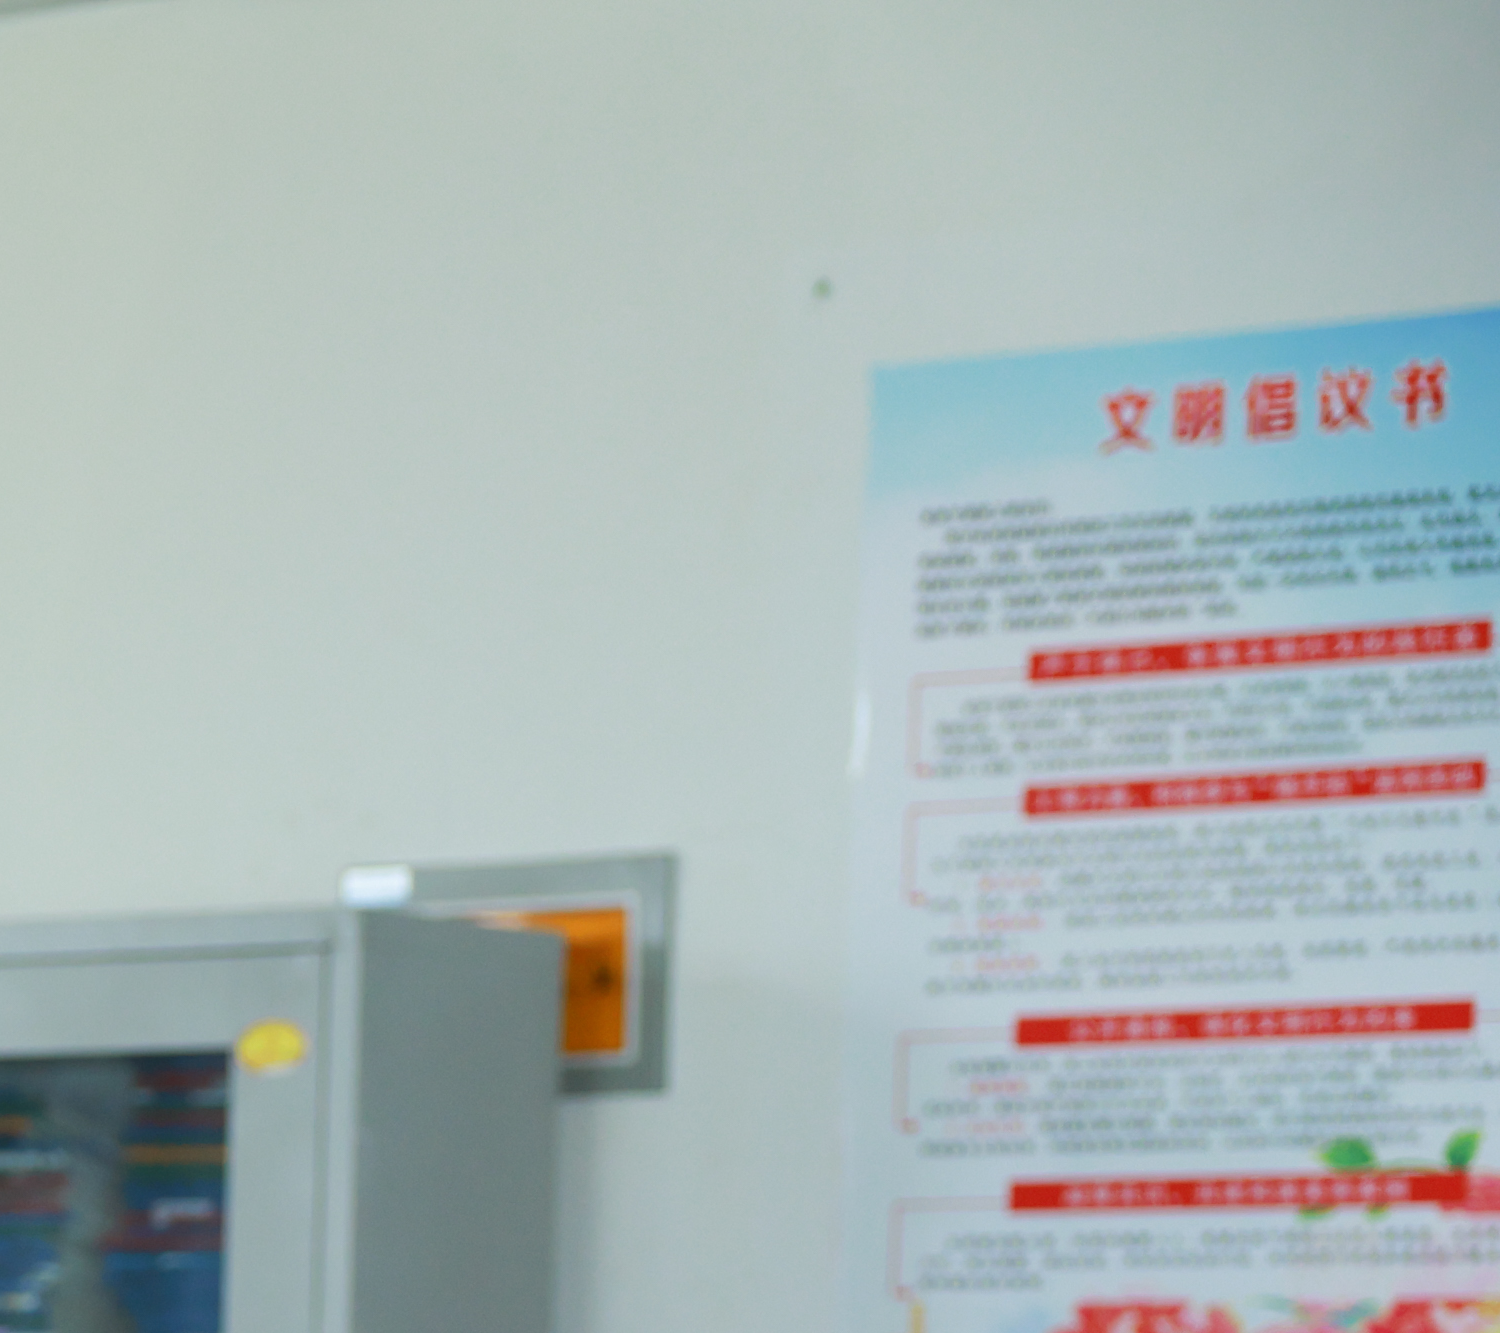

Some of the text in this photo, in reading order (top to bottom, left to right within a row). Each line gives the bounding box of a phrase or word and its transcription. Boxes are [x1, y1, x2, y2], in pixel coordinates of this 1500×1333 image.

[1100, 357, 1449, 455] 文明倡议书
